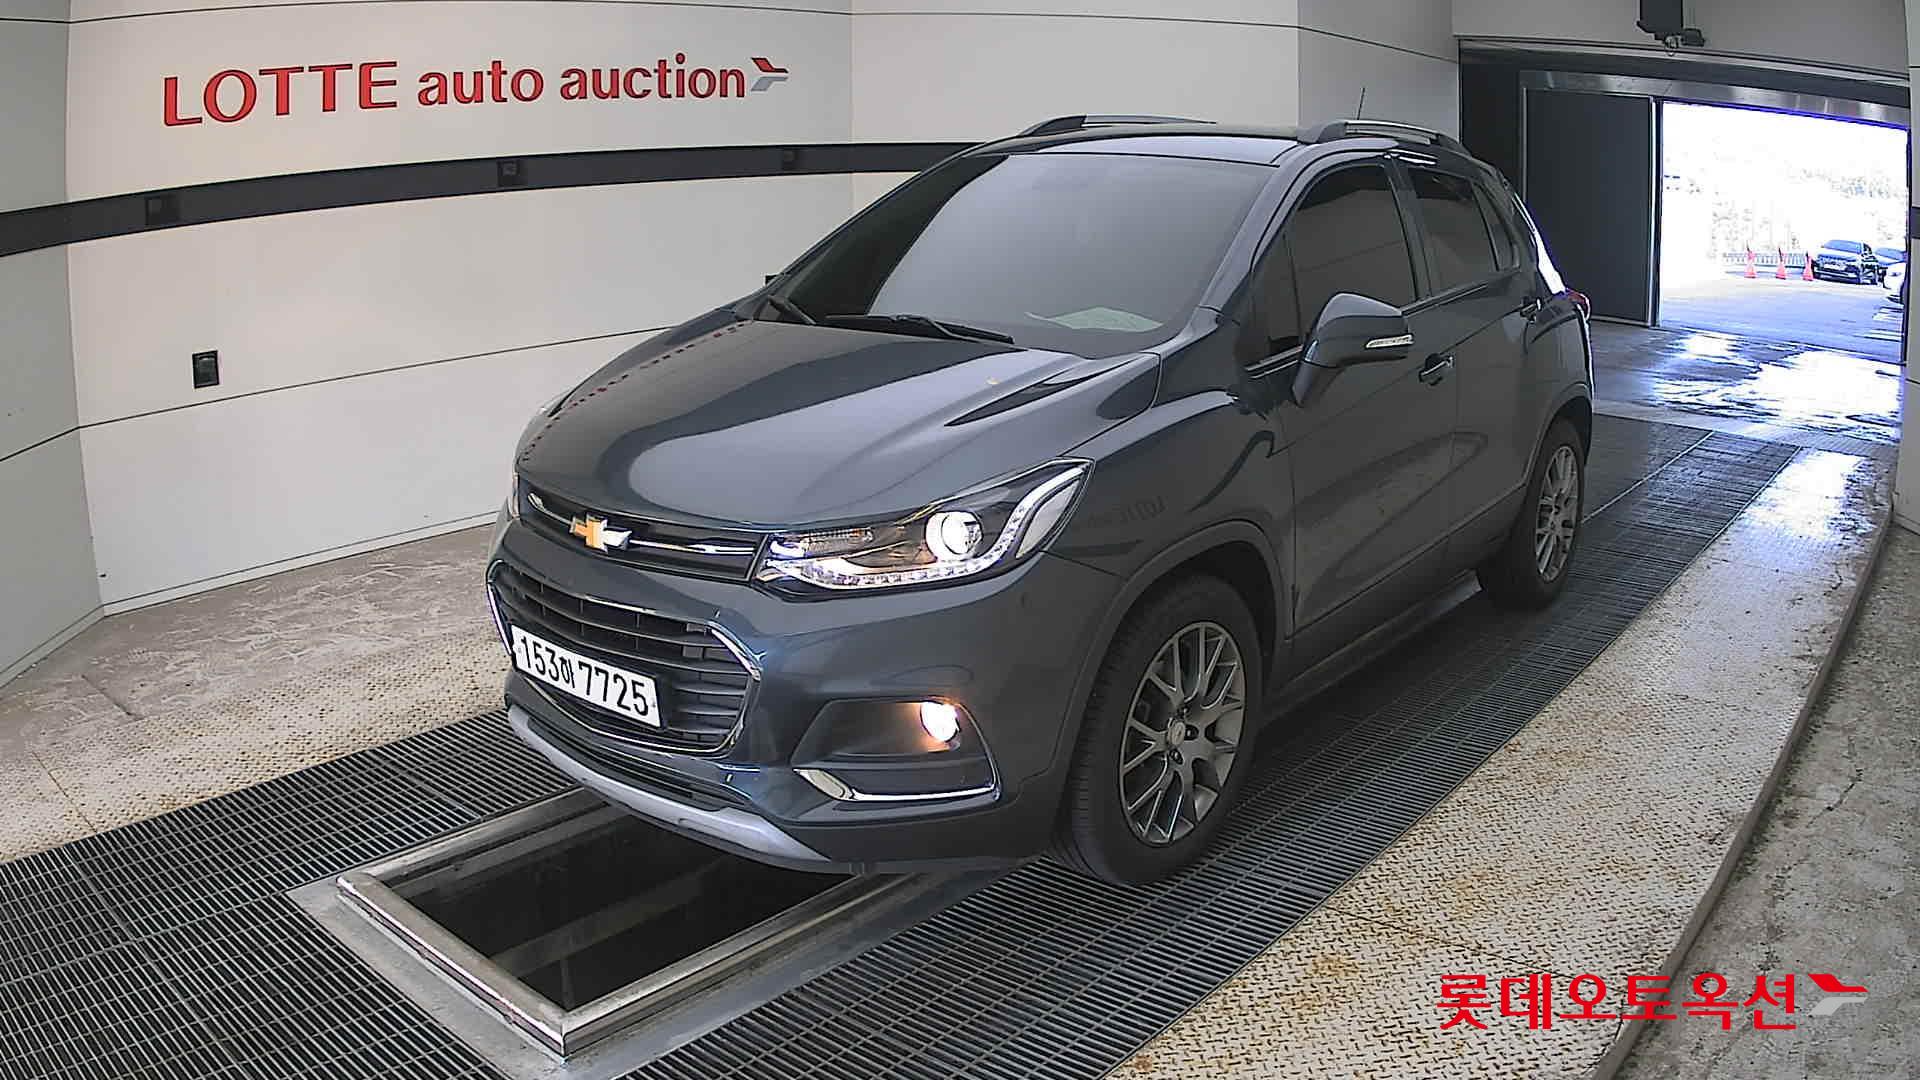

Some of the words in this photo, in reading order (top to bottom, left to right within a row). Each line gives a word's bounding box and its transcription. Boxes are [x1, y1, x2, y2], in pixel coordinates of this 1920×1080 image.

[163, 61, 398, 126] LOTTE
[417, 60, 544, 106] auto
[560, 53, 746, 102] auction
